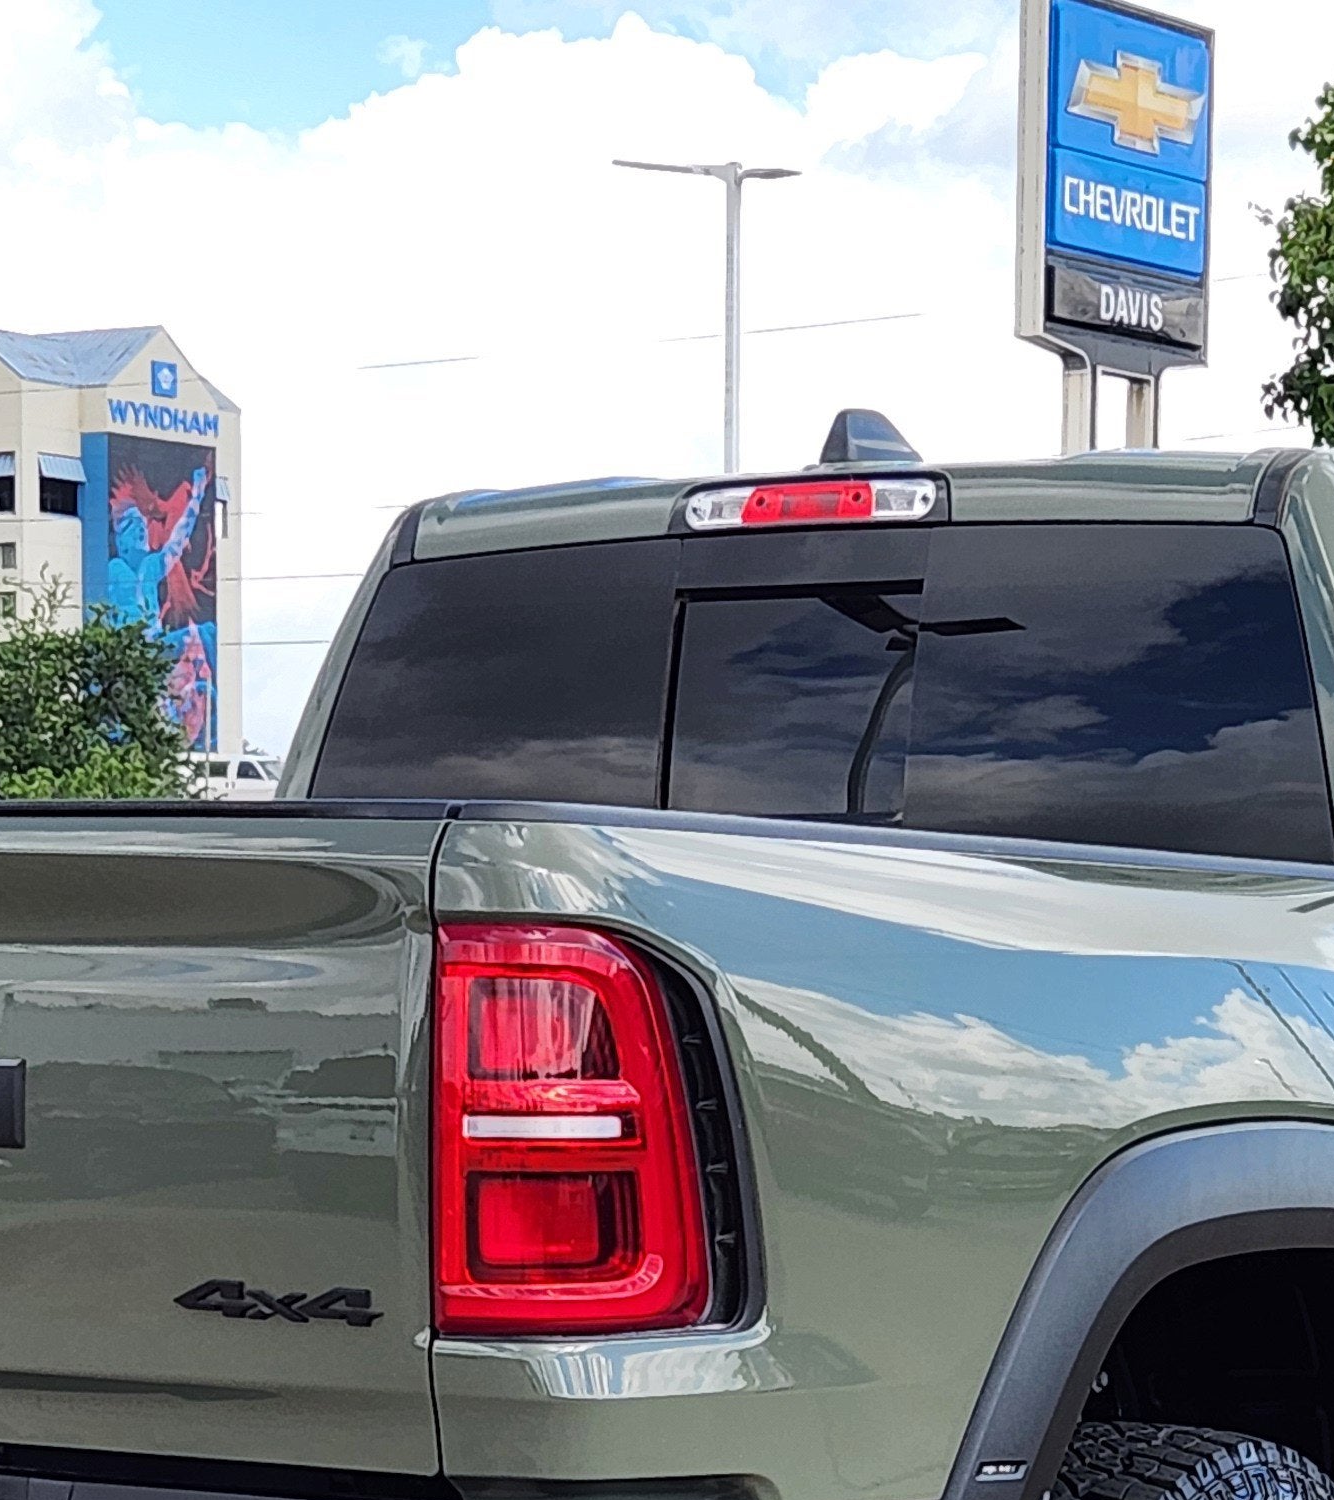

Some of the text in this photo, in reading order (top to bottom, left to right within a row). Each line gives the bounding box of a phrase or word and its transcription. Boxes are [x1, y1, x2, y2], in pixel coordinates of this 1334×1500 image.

[1064, 175, 1200, 241] CHEVROLET
[1099, 284, 1163, 332] DAVIS
[108, 398, 219, 438] WYNDHAM
[173, 1279, 384, 1327] 4x4
